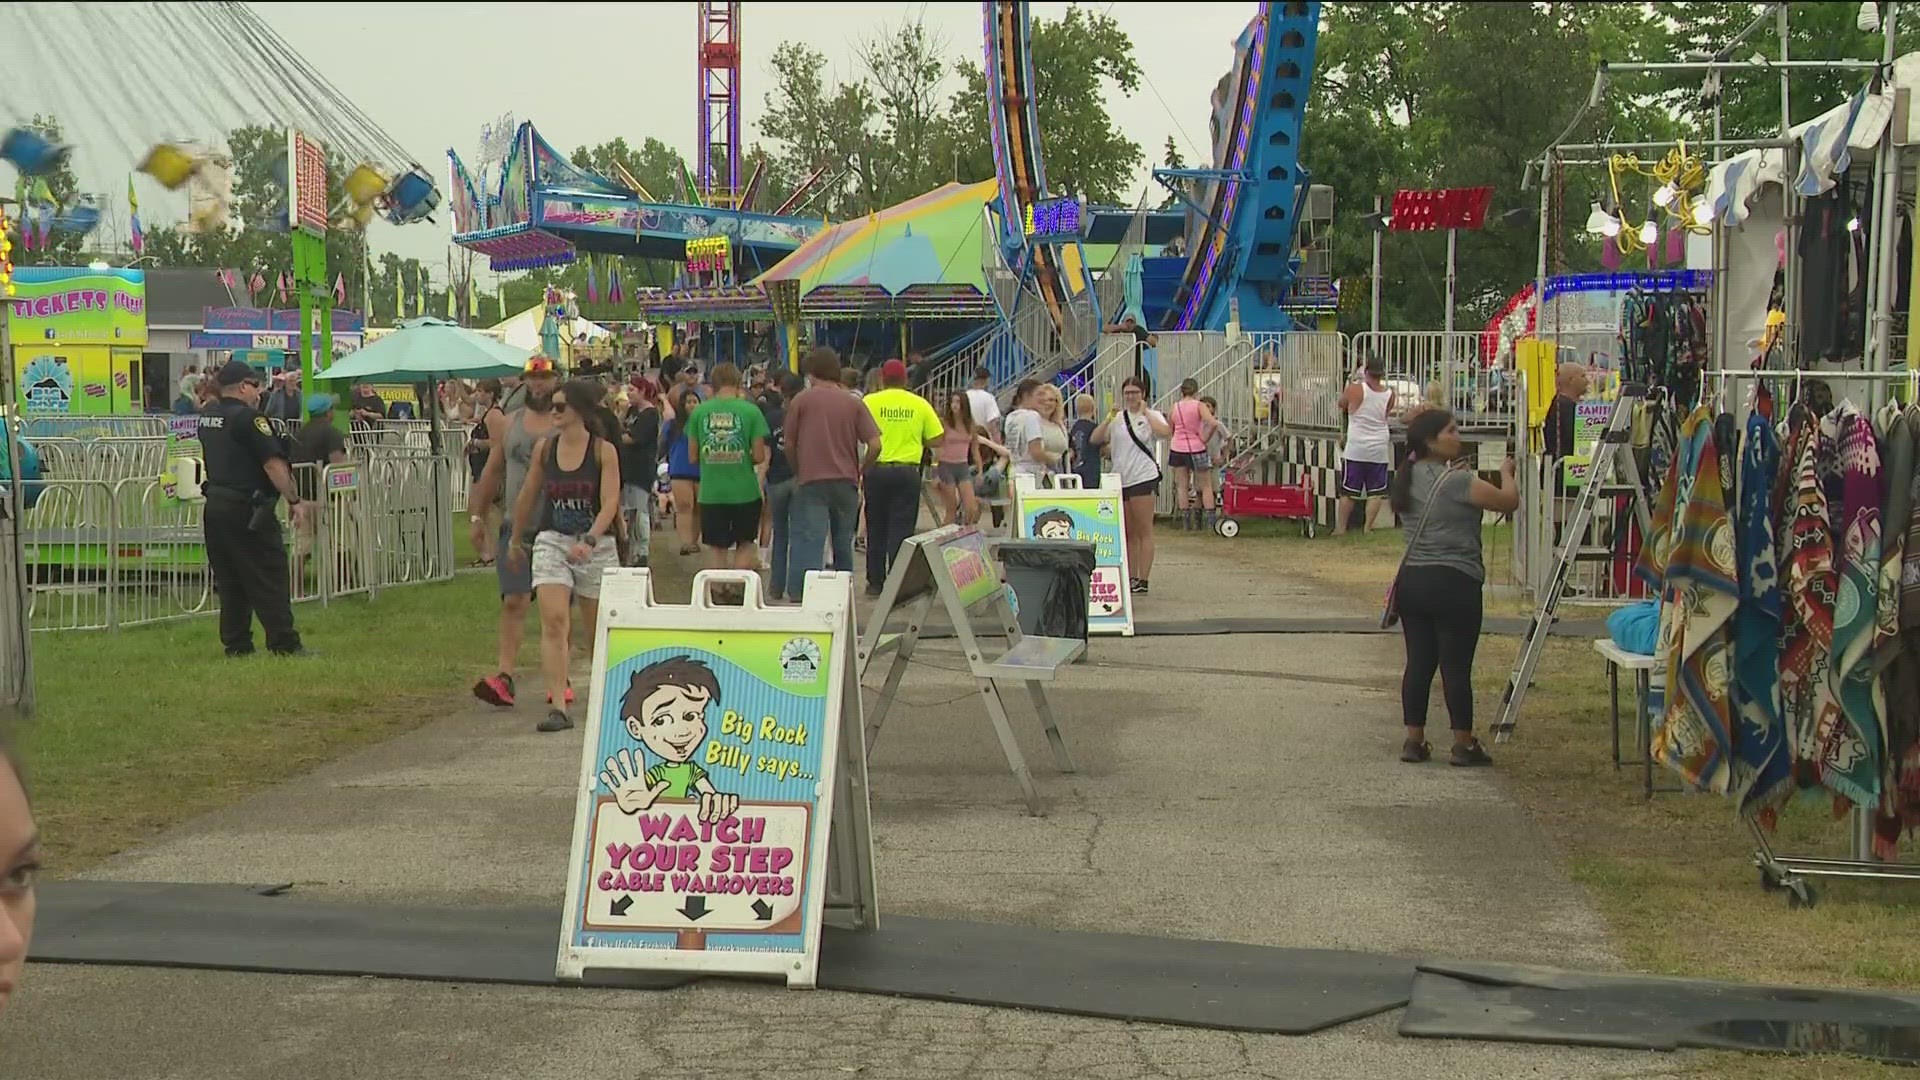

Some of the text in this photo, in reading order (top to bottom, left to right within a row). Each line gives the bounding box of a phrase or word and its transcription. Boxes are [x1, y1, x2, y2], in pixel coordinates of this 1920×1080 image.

[13, 290, 108, 318] TICKETS
[257, 336, 283, 346] Stu's
[1577, 405, 1611, 415] SANITI
[170, 419, 198, 430] SANITIZ
[199, 417, 224, 428] POLICE
[332, 473, 353, 486] EXIT
[1077, 530, 1114, 545] Big Rock
[1091, 583, 1116, 594] TEP
[1090, 594, 1119, 603] OVERS
[721, 709, 808, 746] Big Rock
[705, 740, 814, 781] Billy says...
[638, 813, 766, 843] WATCH
[605, 842, 794, 874] YOUR STEP
[597, 871, 794, 896] CABLE WALKOVERS
